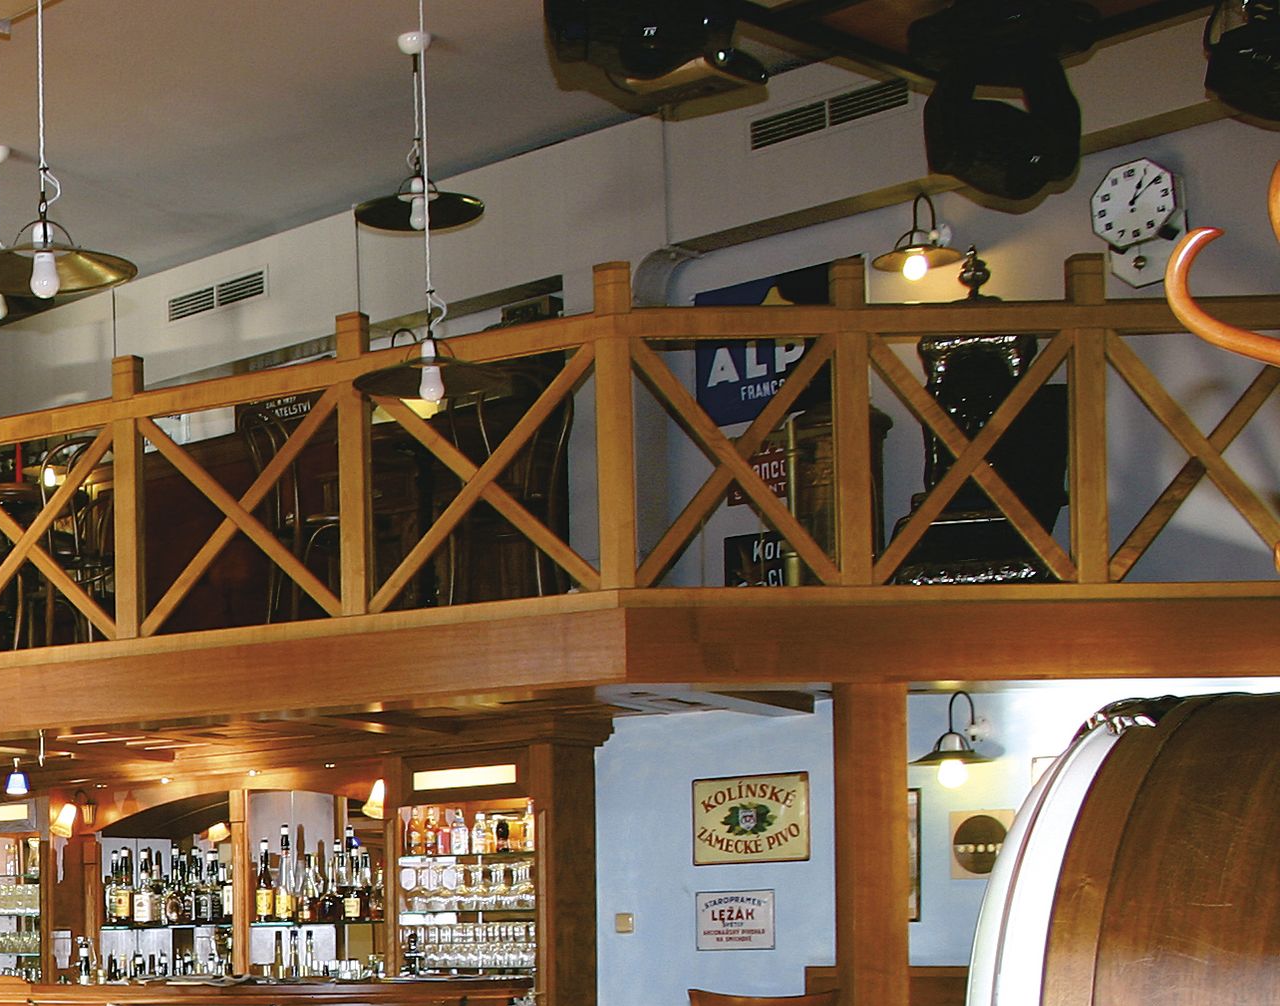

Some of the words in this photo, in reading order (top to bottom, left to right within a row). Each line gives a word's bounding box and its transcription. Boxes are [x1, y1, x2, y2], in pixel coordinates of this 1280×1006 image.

[707, 338, 805, 388] ALP
[741, 379, 786, 400] FRANC
[701, 781, 796, 813] KOLÍNSKÉ
[697, 826, 763, 854] ZÁMECKÉ
[766, 823, 800, 850] PIVO
[711, 906, 754, 921] LEŽÁK
